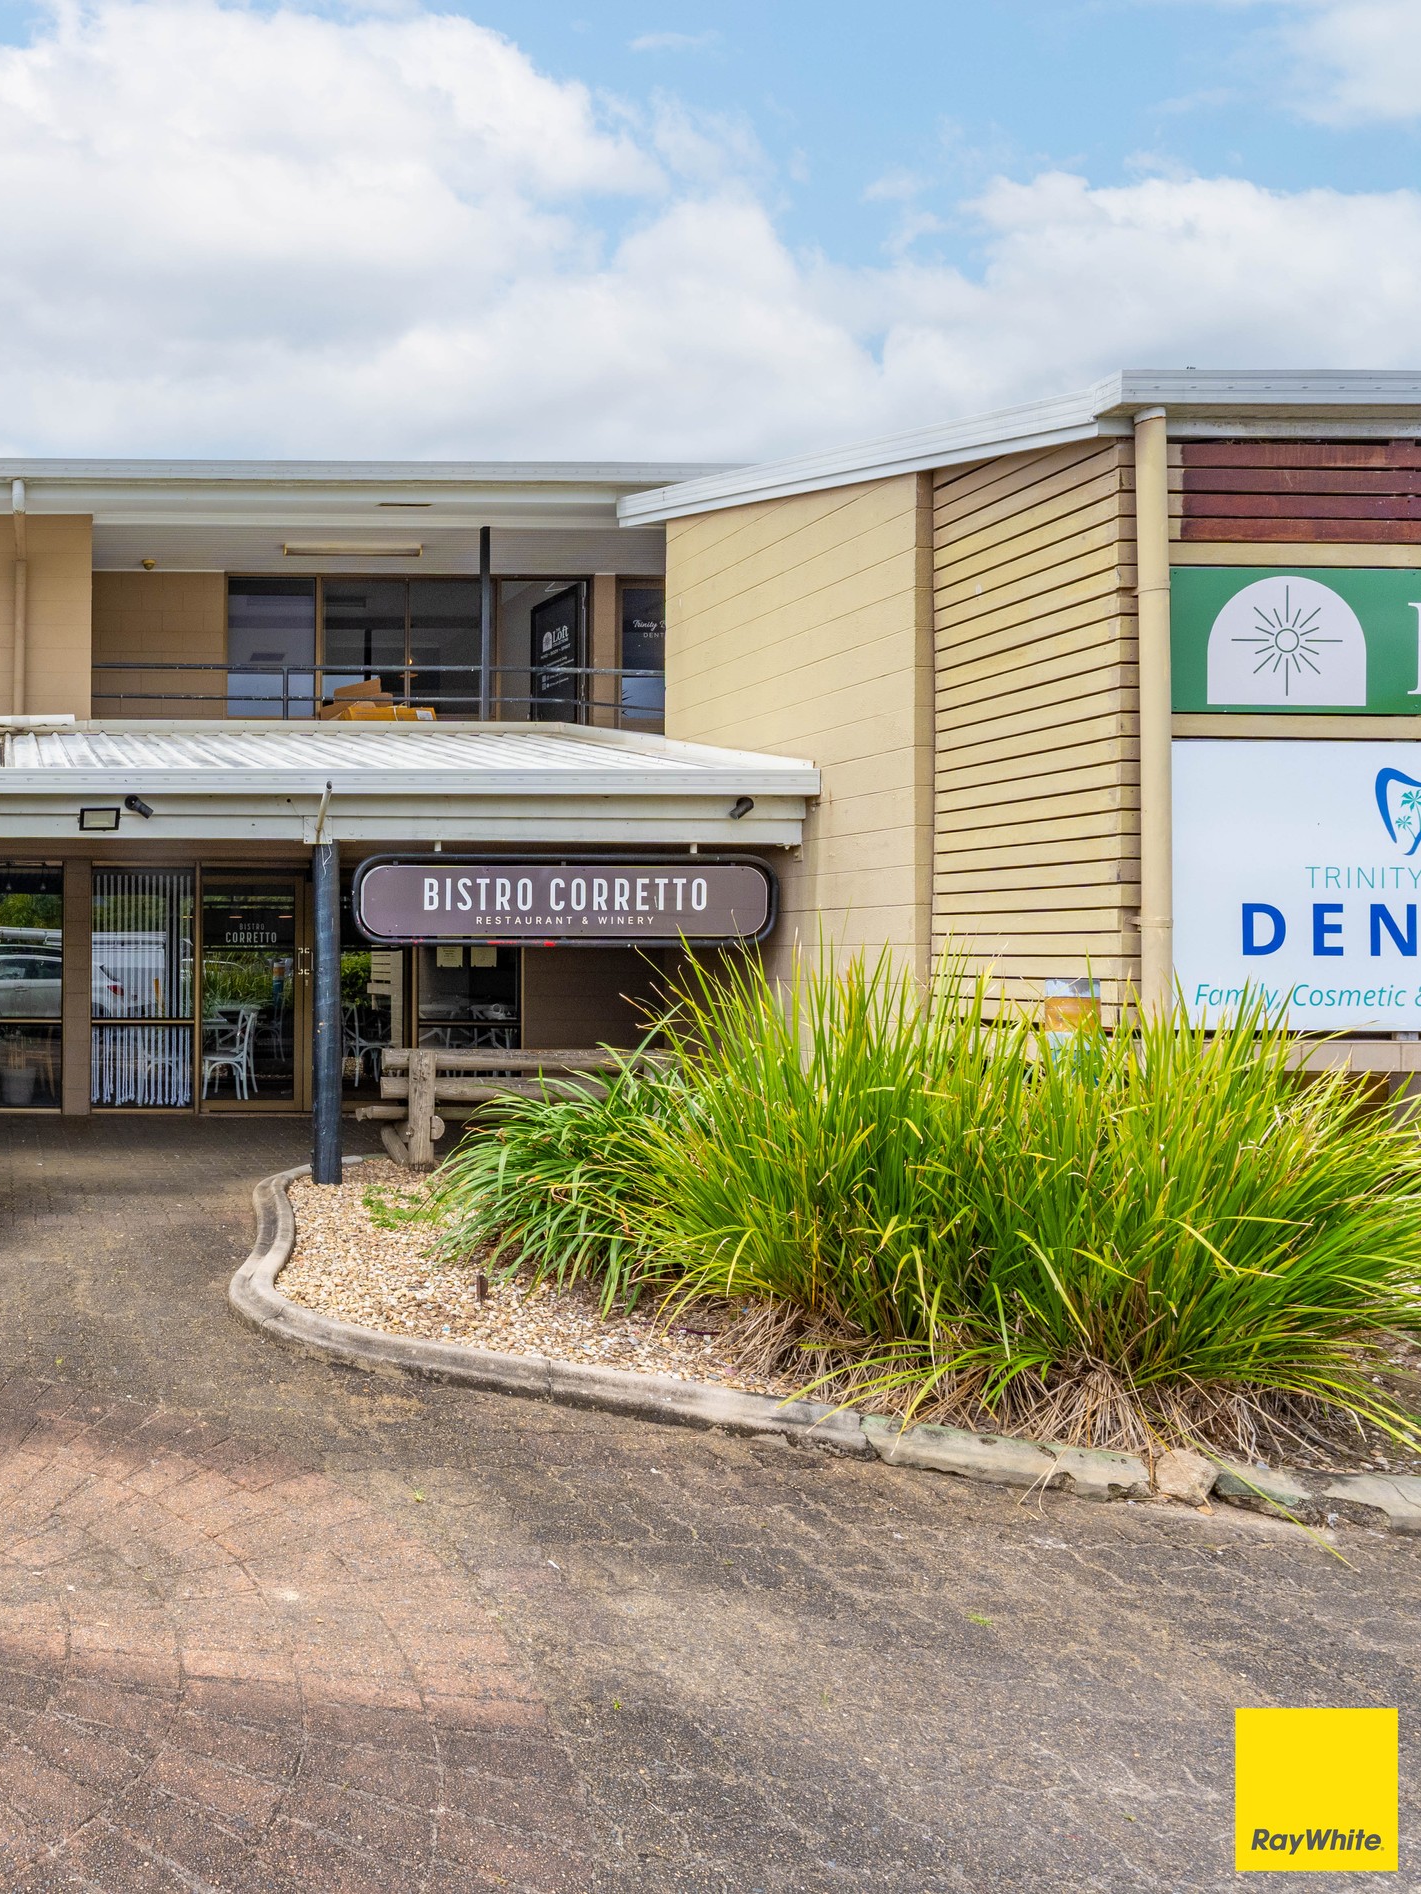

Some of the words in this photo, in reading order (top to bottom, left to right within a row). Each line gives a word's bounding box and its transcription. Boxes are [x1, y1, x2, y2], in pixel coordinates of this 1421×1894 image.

[1305, 866, 1421, 889] TRINITY
[423, 878, 533, 911] BISTRO
[549, 878, 708, 911] CORRETTO
[239, 922, 265, 931] BISTRO
[475, 916, 574, 925] RESTAURANT
[581, 916, 589, 925] &
[597, 916, 655, 925] WINERY
[1241, 902, 1417, 957] DEN
[225, 931, 277, 943] CORRETTO
[1293, 983, 1407, 1007] Cosmetic
